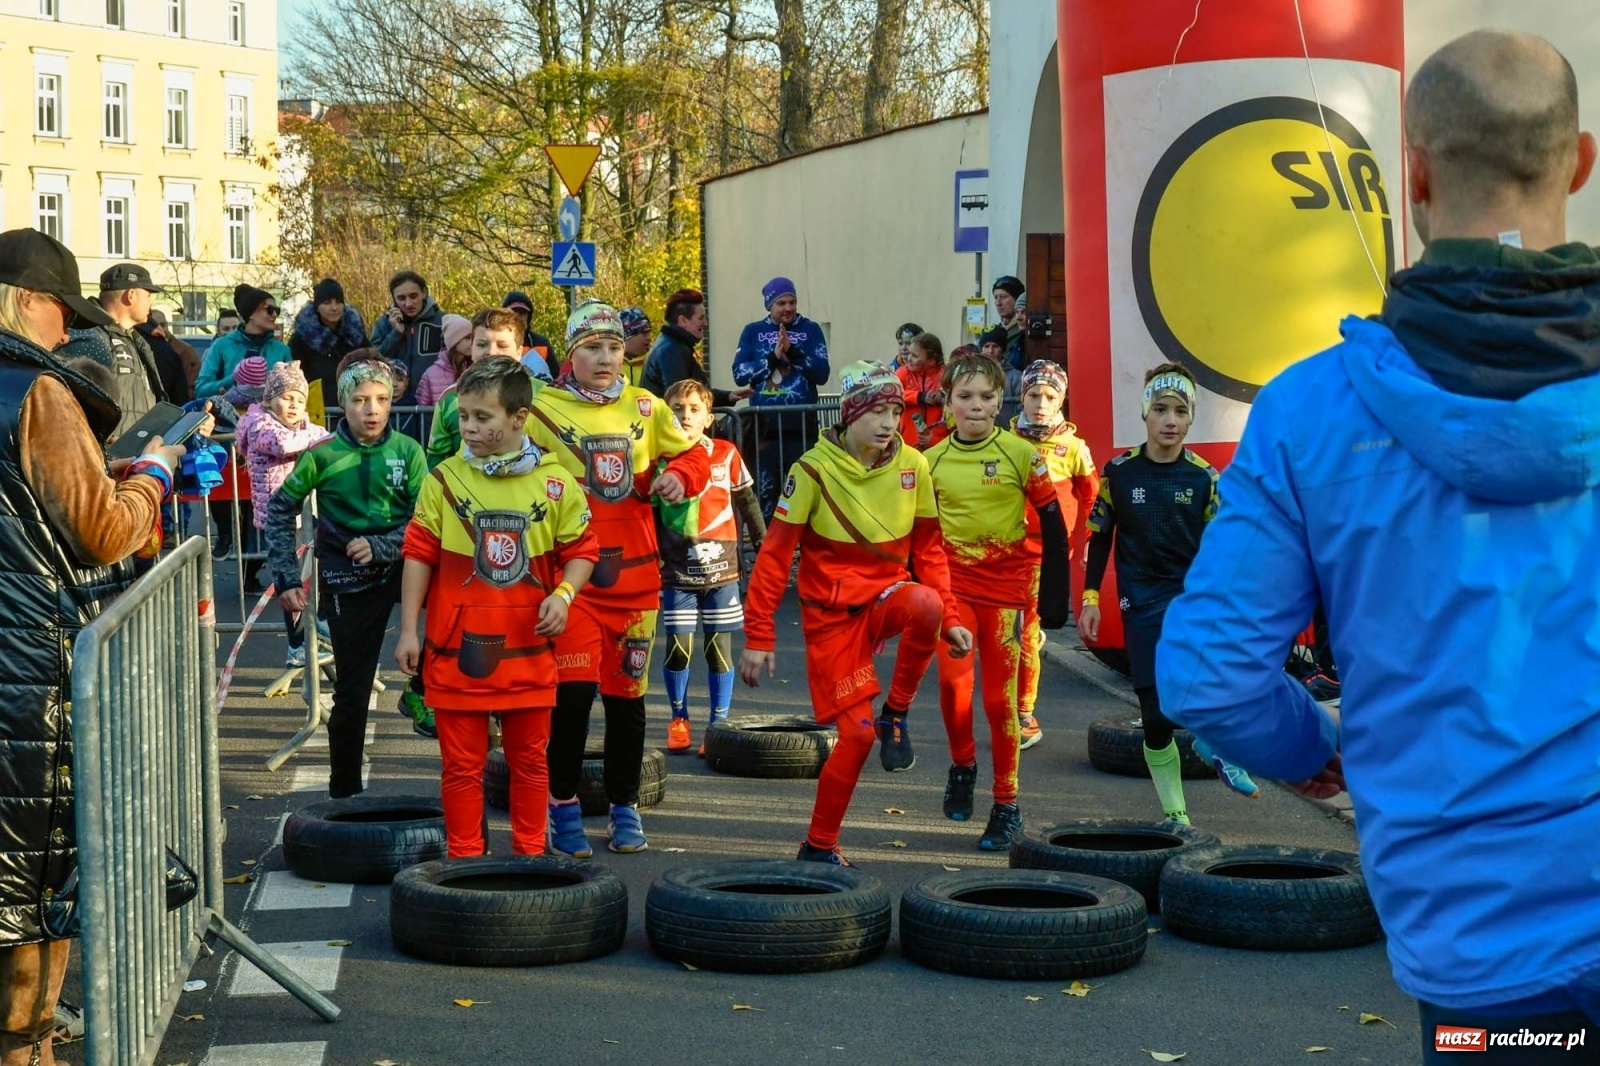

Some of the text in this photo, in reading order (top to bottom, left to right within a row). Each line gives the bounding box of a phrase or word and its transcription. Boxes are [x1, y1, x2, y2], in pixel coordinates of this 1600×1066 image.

[1271, 150, 1390, 215] SIR
[1154, 376, 1186, 392] ELITA
[487, 429, 504, 442] 30
[604, 486, 620, 497] OCR
[492, 570, 509, 581] OCR
